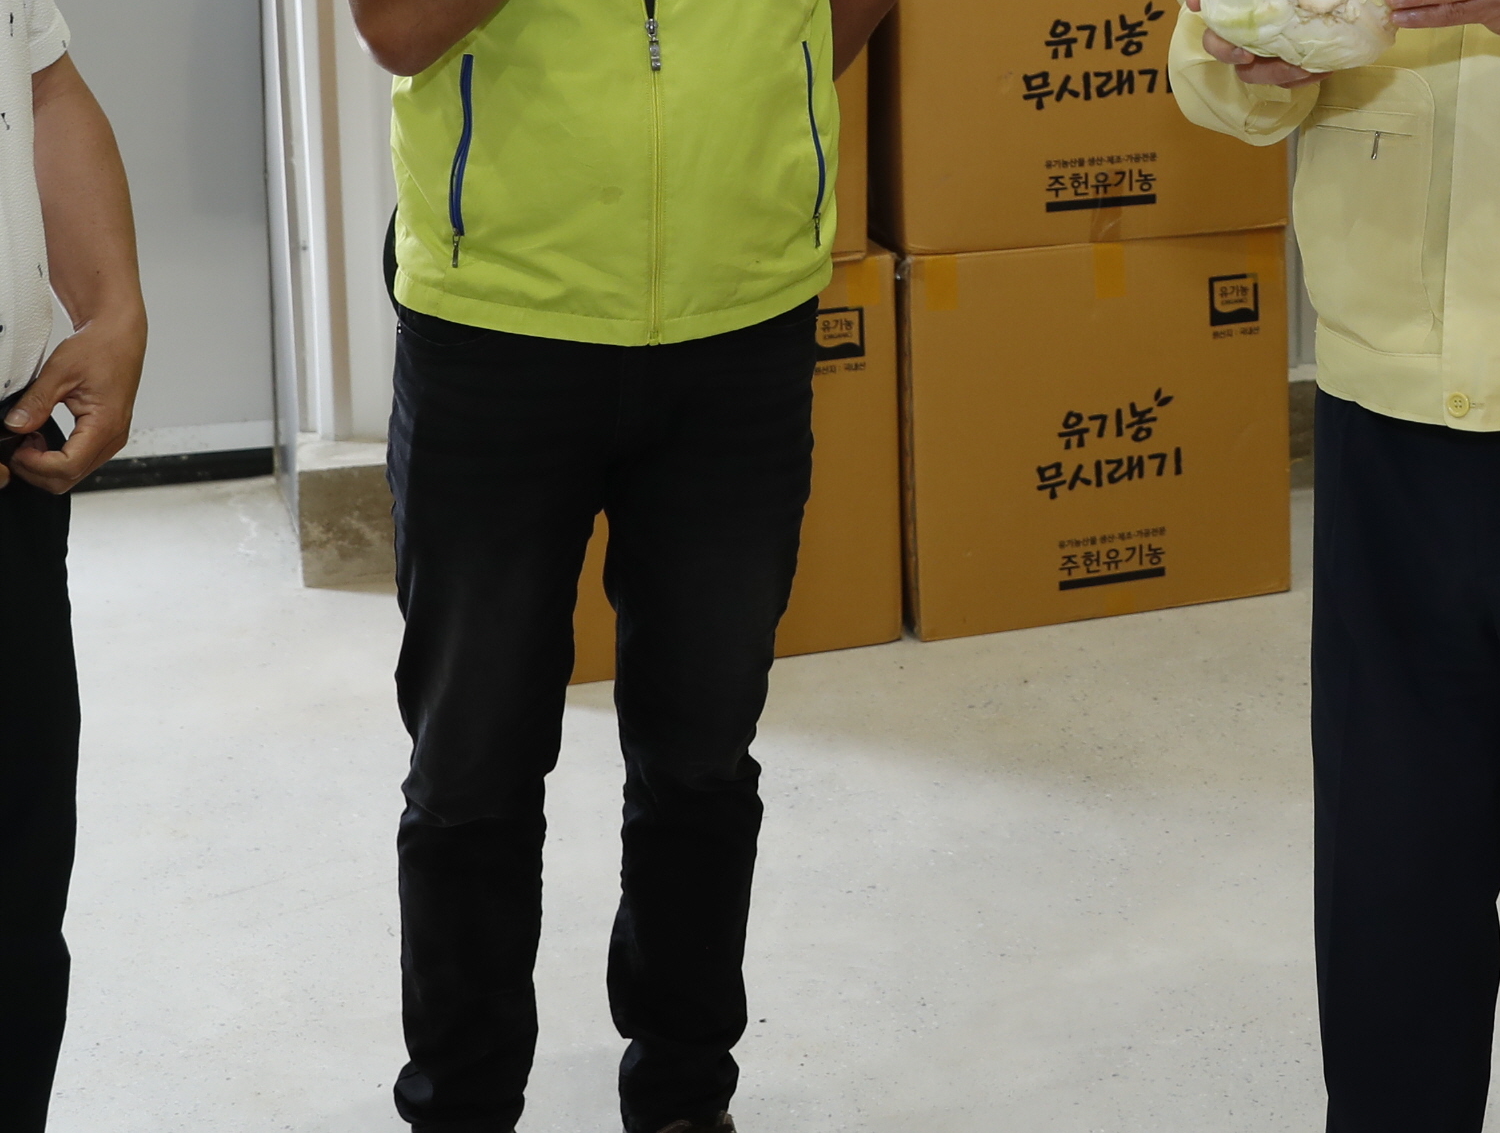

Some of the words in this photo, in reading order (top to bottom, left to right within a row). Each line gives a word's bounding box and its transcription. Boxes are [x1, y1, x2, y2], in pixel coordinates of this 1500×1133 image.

[1044, 14, 1148, 59] 유기농
[1022, 64, 1173, 110] 무시래기
[1045, 168, 1157, 198] 주헌유기농
[1219, 285, 1249, 298] 유기농
[822, 318, 854, 333] 유기농
[1057, 402, 1157, 450] 유기농
[1036, 447, 1182, 500] 무시래기
[1059, 543, 1166, 576] 주헌유기농
